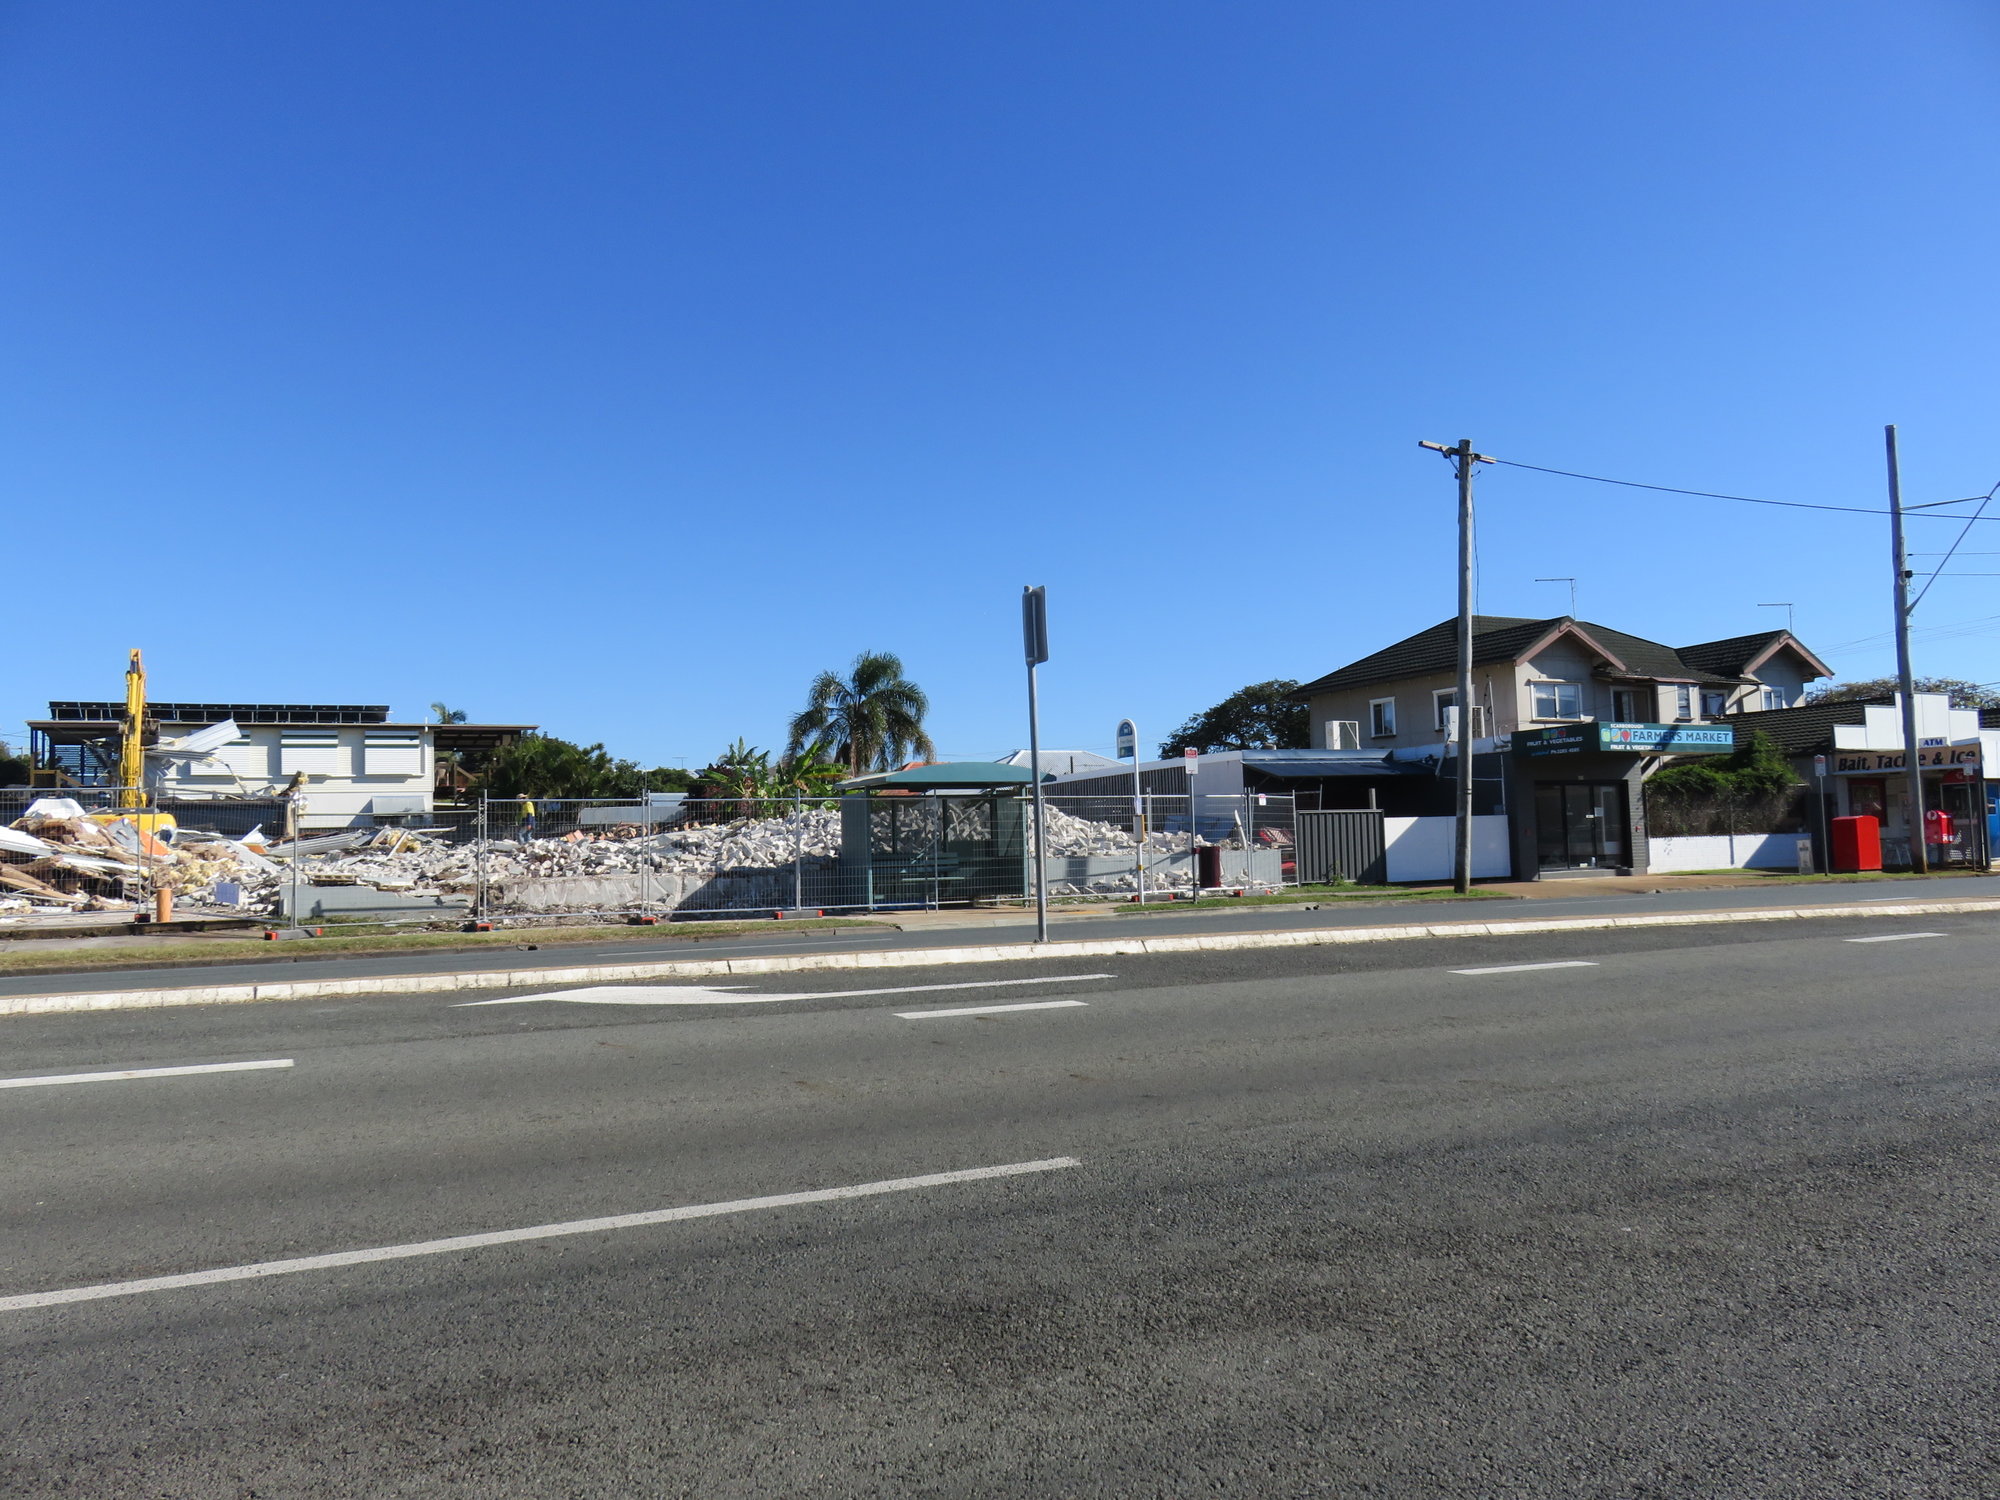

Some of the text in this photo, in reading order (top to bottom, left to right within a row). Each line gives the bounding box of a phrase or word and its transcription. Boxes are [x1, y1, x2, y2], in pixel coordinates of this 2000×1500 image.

[1685, 732, 1730, 743] MARKET
[1923, 738, 1943, 747] ATM
[1838, 756, 1871, 772] Bait,
[1932, 751, 1943, 765] &
